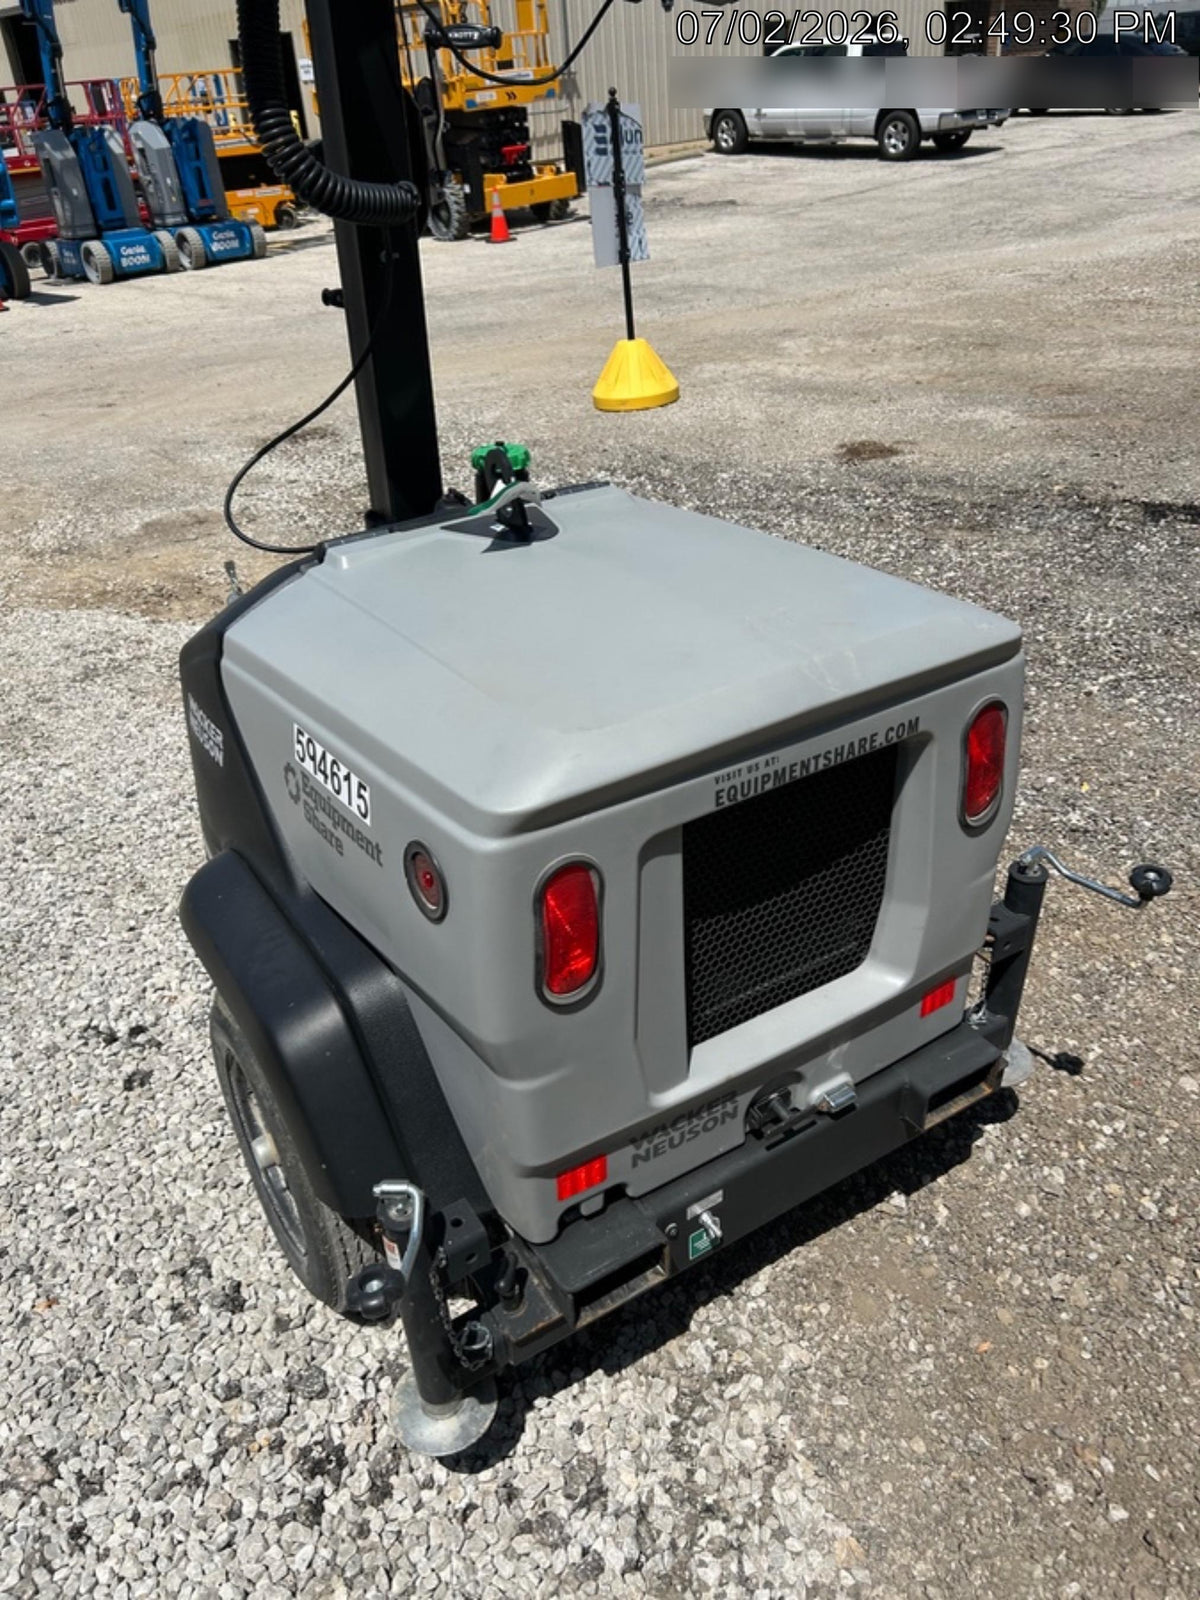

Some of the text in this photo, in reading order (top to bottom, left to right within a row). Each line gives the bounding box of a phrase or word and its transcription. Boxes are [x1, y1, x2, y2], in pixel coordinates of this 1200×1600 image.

[120, 244, 147, 256] Genie
[296, 728, 369, 820] 594615
[714, 757, 780, 784] VISIT US AT:
[715, 716, 920, 807] EQUIPMENTSHARE.COM
[300, 771, 384, 868] Equipment
[303, 803, 344, 857] Share
[629, 1090, 738, 1151] WACKER
[631, 1105, 739, 1169] NEUSON
